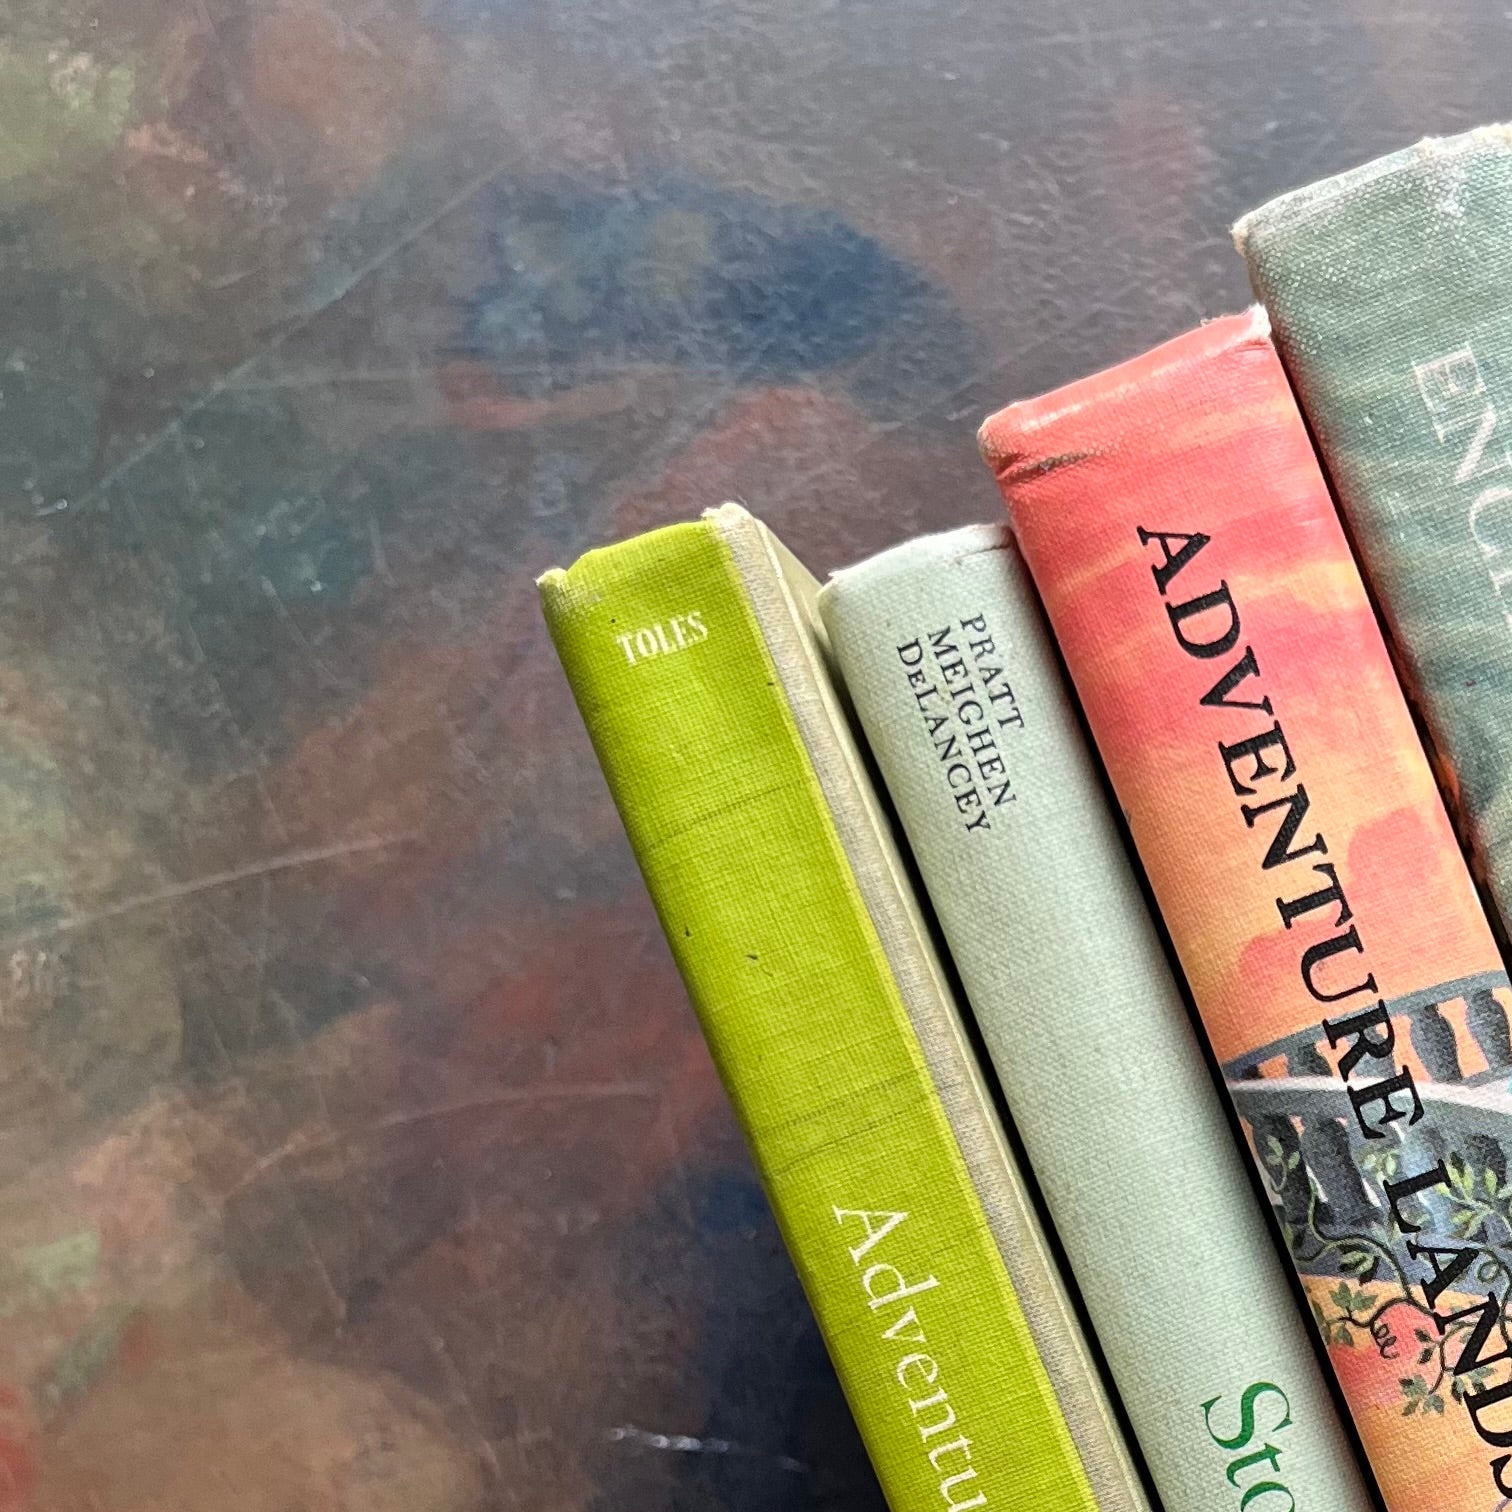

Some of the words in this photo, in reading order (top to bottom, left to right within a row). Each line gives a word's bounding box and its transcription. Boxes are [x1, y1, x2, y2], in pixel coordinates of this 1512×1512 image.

[616, 610, 710, 668] TOLES
[959, 613, 1025, 731] PRATT
[928, 625, 1017, 808] MEIGHEN
[1136, 524, 1428, 1142] ADVENTURE
